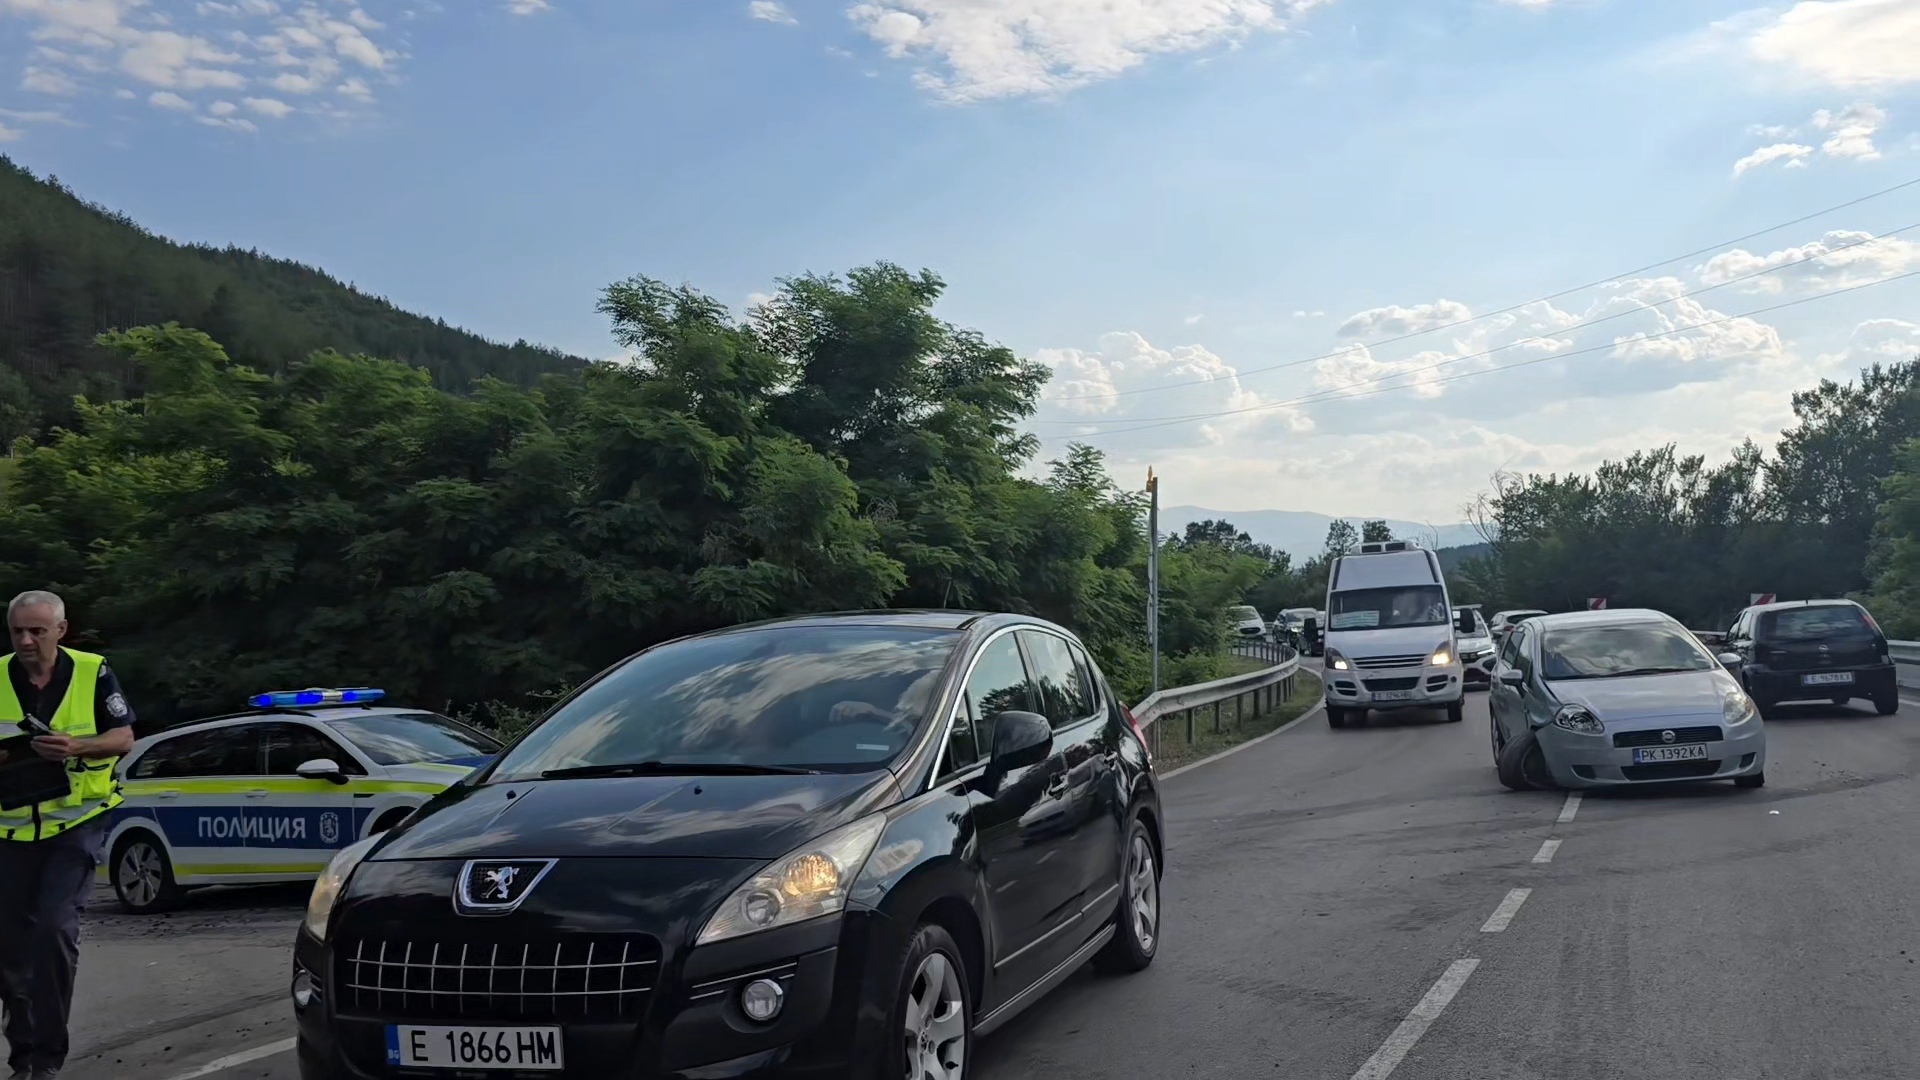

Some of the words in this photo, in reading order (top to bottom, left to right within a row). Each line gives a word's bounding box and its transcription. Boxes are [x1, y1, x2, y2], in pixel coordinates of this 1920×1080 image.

[1641, 749, 1657, 761] PK
[1660, 746, 1704, 760] 1392KA
[198, 816, 306, 843] ПОЛИЦИЯ
[388, 1049, 399, 1060] BG
[411, 1030, 428, 1062] E
[446, 1031, 556, 1064] 1866HM
